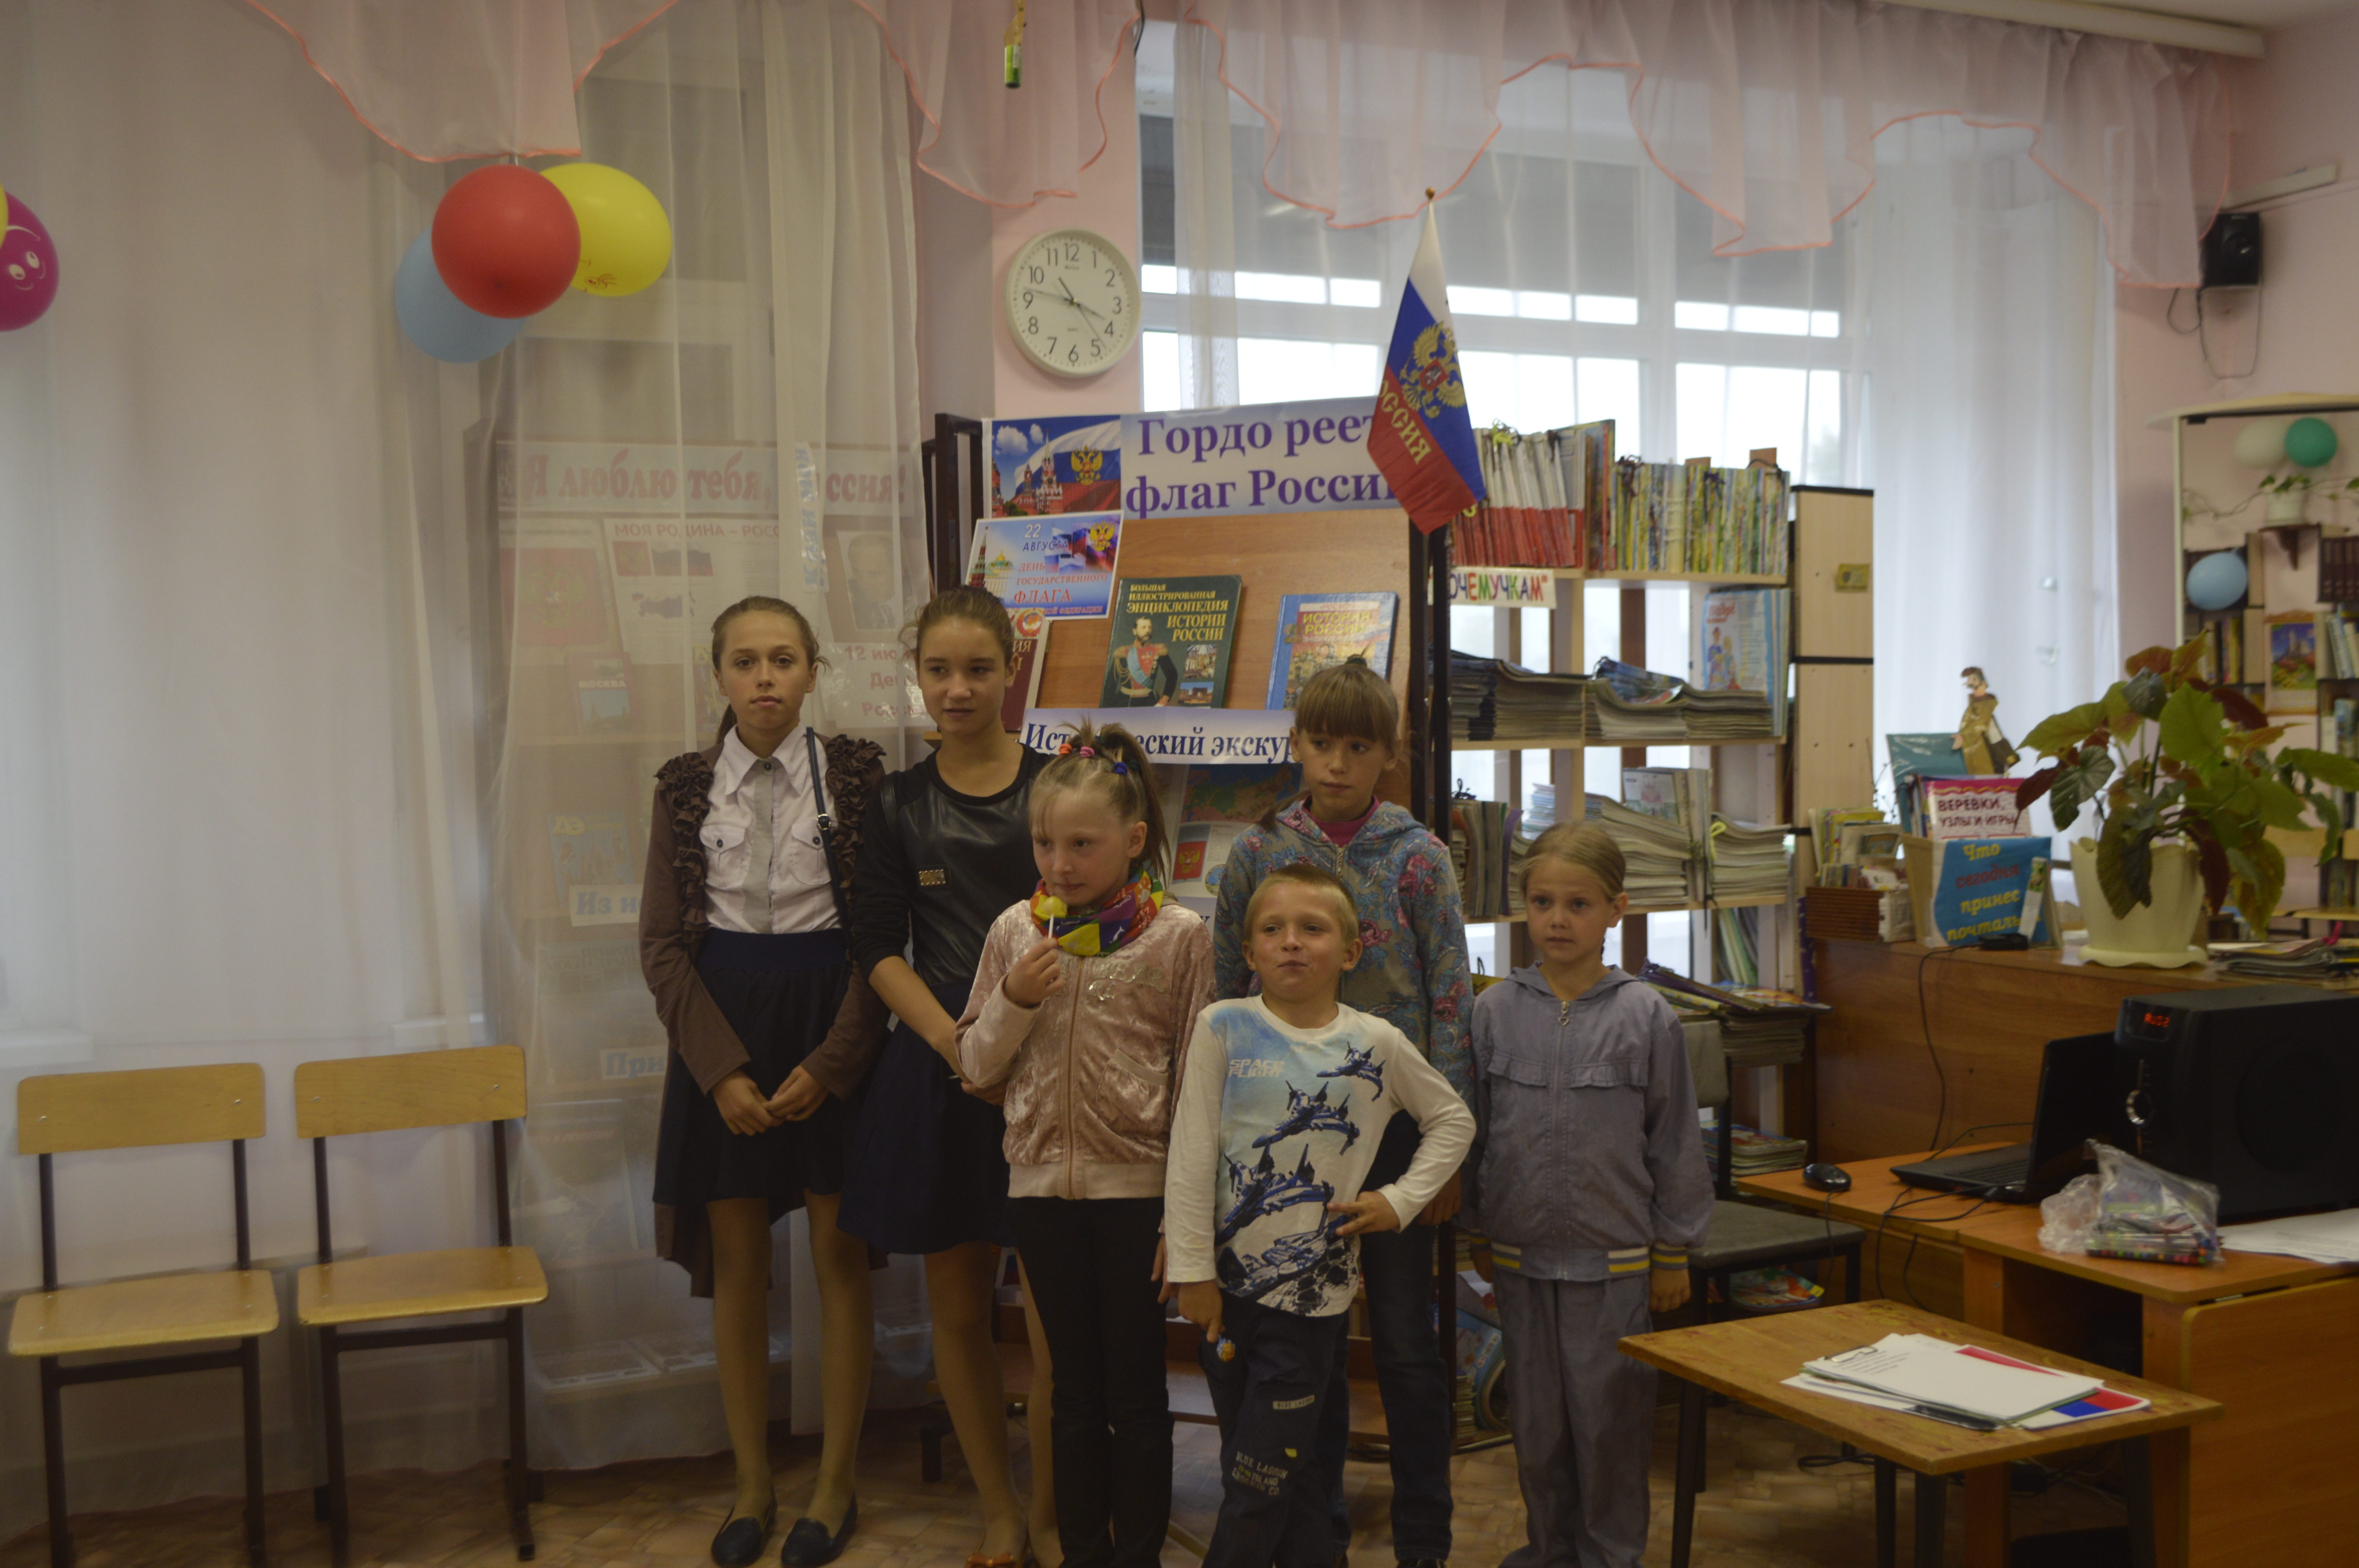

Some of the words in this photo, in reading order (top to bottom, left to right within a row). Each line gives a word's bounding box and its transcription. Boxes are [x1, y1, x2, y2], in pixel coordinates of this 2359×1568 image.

[1046, 247, 1058, 267] 11
[1064, 243, 1080, 262] 12
[1092, 250, 1097, 269] 1
[1029, 266, 1044, 285] 10
[1105, 269, 1116, 287] 2
[1023, 291, 1034, 309] 9
[1112, 296, 1122, 315] 3
[1028, 316, 1039, 335] 8
[1104, 320, 1114, 338] 4
[1047, 336, 1057, 354] 7
[1068, 344, 1079, 363] 6
[1090, 338, 1101, 357] 5
[1138, 418, 1272, 463] Гордо
[524, 454, 549, 500] Я
[558, 447, 677, 499] люблю
[687, 450, 772, 508] тебя,
[1125, 475, 1236, 519] флаг
[614, 524, 652, 537] МОЯ
[743, 524, 779, 538] РОСС
[1024, 523, 1042, 539] 22
[1022, 539, 1069, 552] АВГУСТА
[1018, 562, 1045, 572] ДЕНЬ
[1016, 573, 1108, 586] ГОСУДАРСТВЕННОГО
[1013, 589, 1072, 604] ФЛАГА
[1129, 591, 1216, 601] ИЛЛЮСТРИРОВАННАЯ
[1127, 600, 1229, 615] ЭНЦИКЛОПЕДИЯ
[1166, 613, 1227, 628] ИСТОРИИ
[1302, 612, 1371, 624] ИСТОРИЯ
[1172, 628, 1225, 642] РОССИИ
[1305, 623, 1366, 635] РОССИИ
[845, 645, 867, 661] 12
[578, 680, 627, 688] МОСКВА
[1973, 816, 1981, 825] И
[1963, 843, 2001, 861] Что
[1956, 864, 2021, 888] сегодня
[576, 891, 612, 916] Из
[1961, 889, 2021, 916] принес
[1946, 915, 2041, 941] почталь
[605, 1052, 666, 1078] При
[1228, 1067, 1284, 1078] FLIGHT
[1229, 1058, 1285, 1069] SPACE
[1236, 1451, 1254, 1468] BLUE
